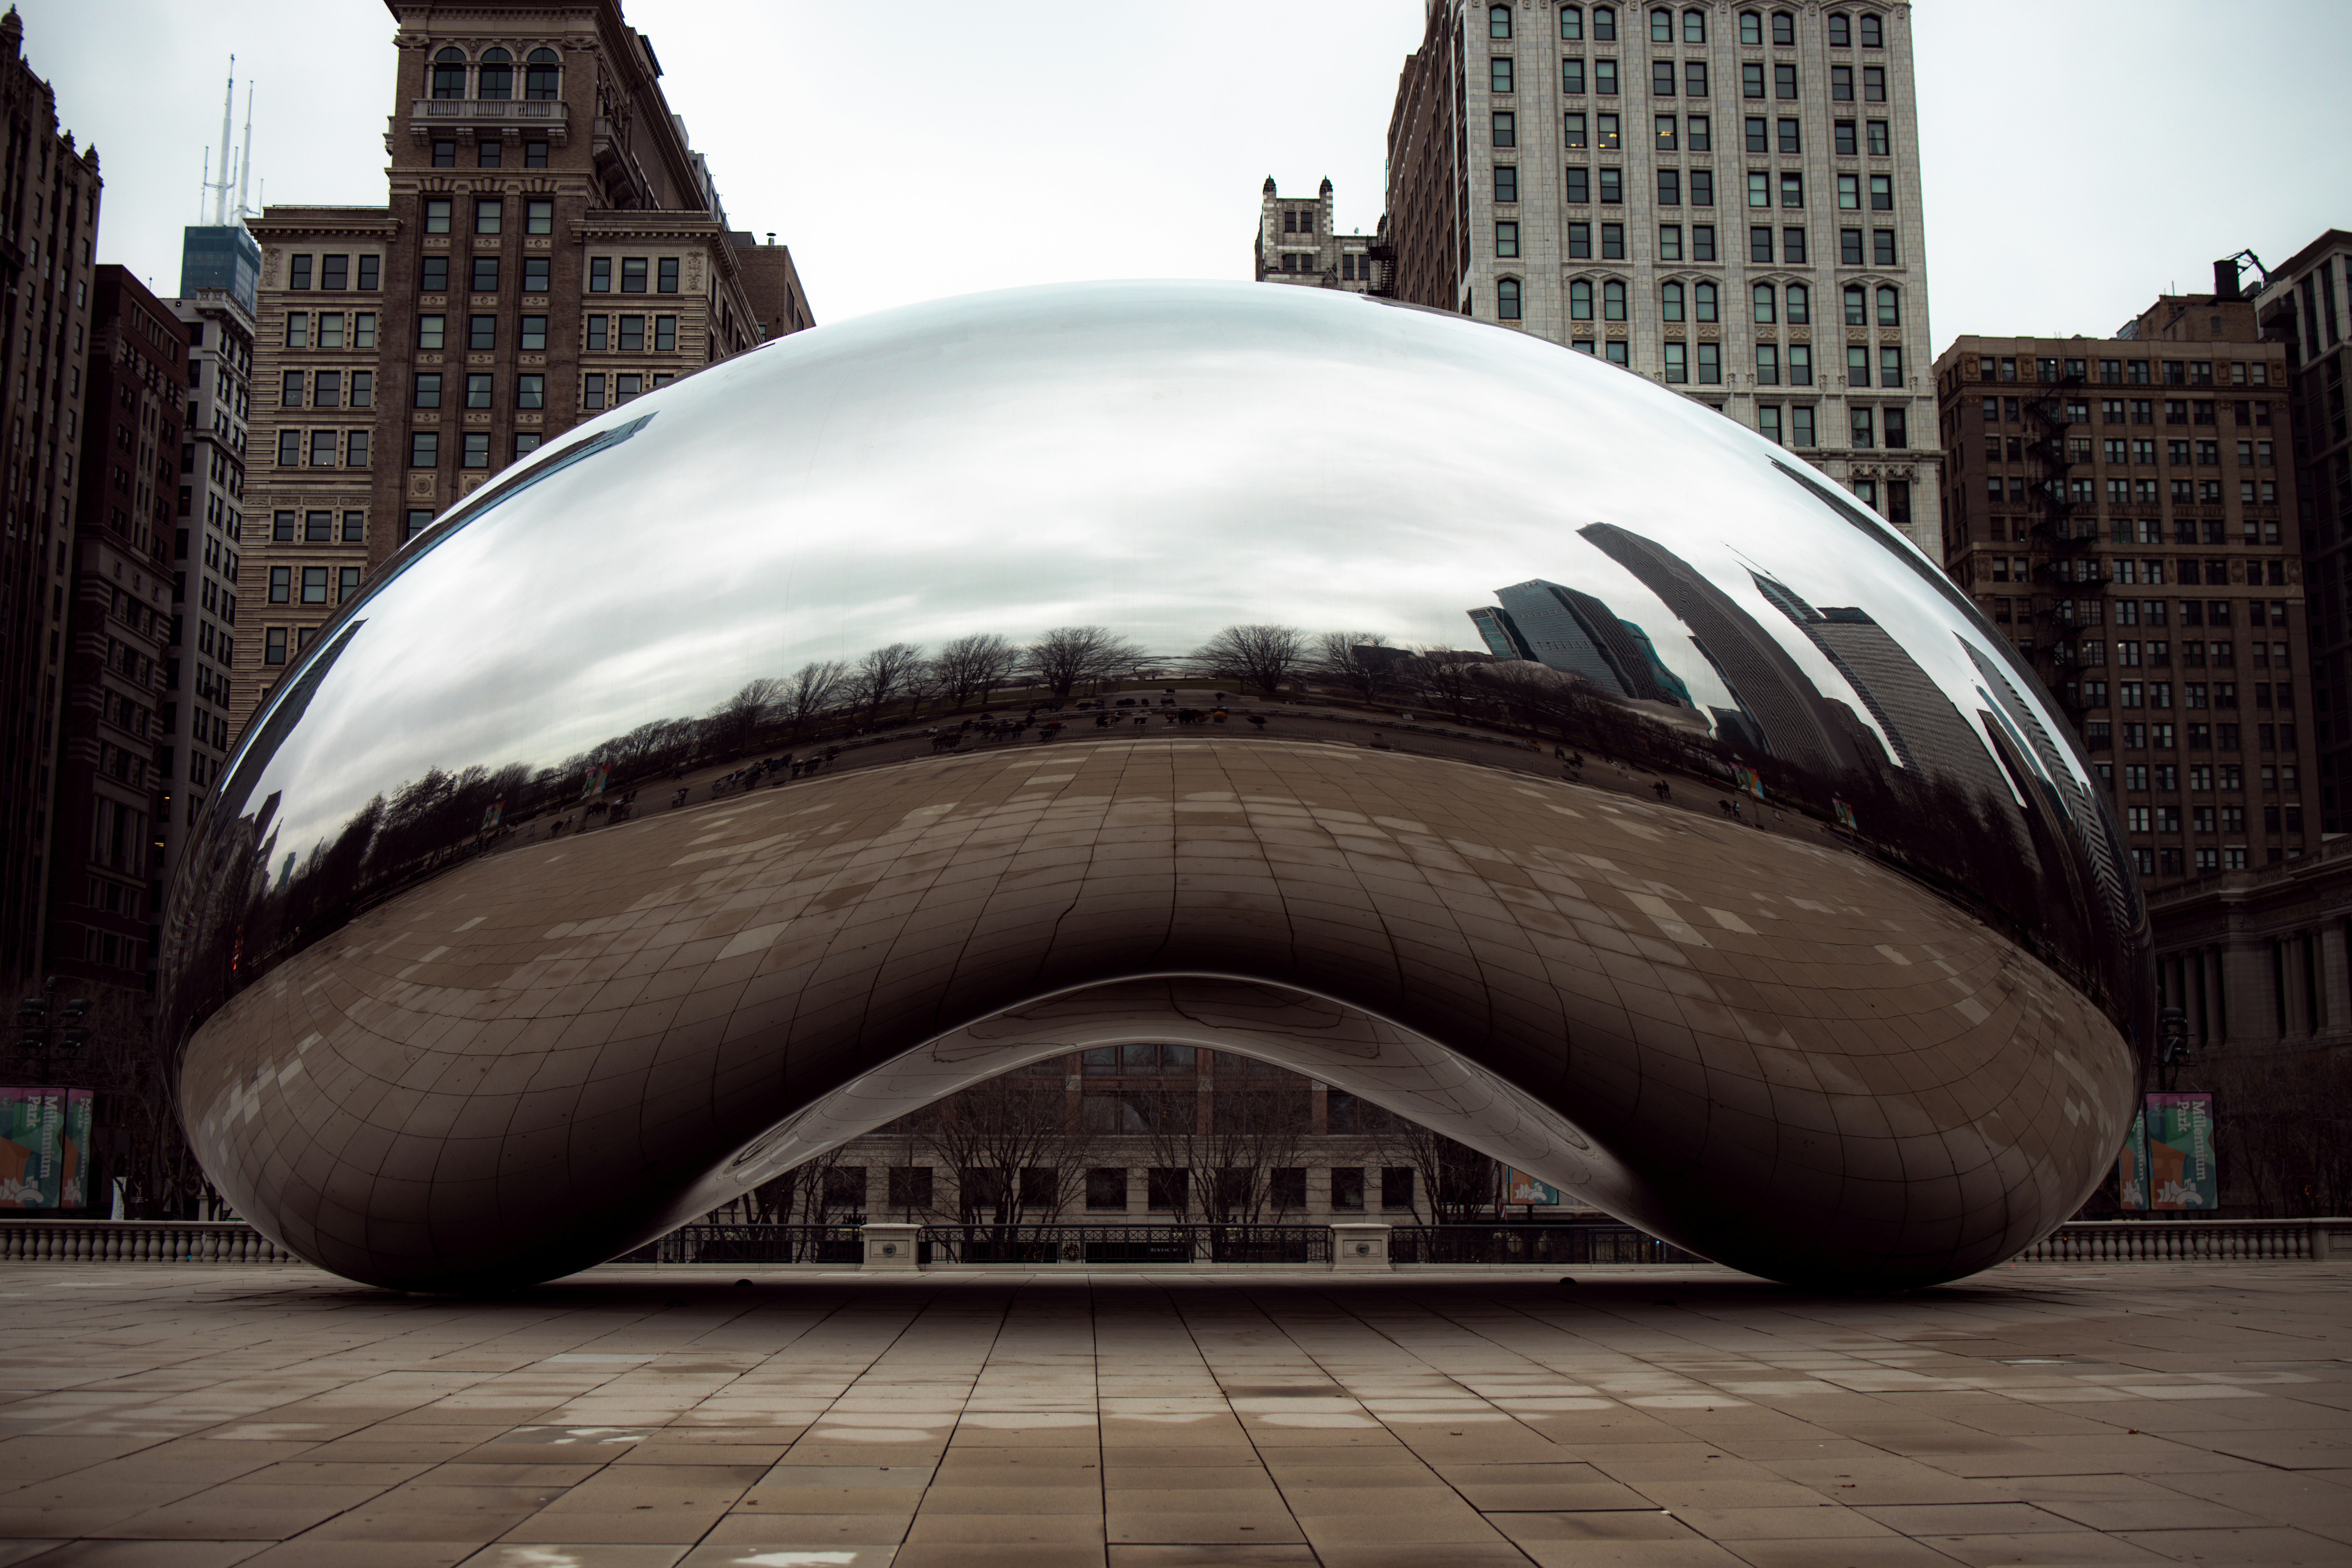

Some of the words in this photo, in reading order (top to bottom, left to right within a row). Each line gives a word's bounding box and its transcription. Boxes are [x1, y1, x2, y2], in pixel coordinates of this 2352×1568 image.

[27, 1095, 41, 1128] Park
[40, 1095, 58, 1178] Millennium
[80, 1097, 91, 1178] Millennium
[2177, 1101, 2192, 1132] Park
[2192, 1101, 2206, 1181] Millennium
